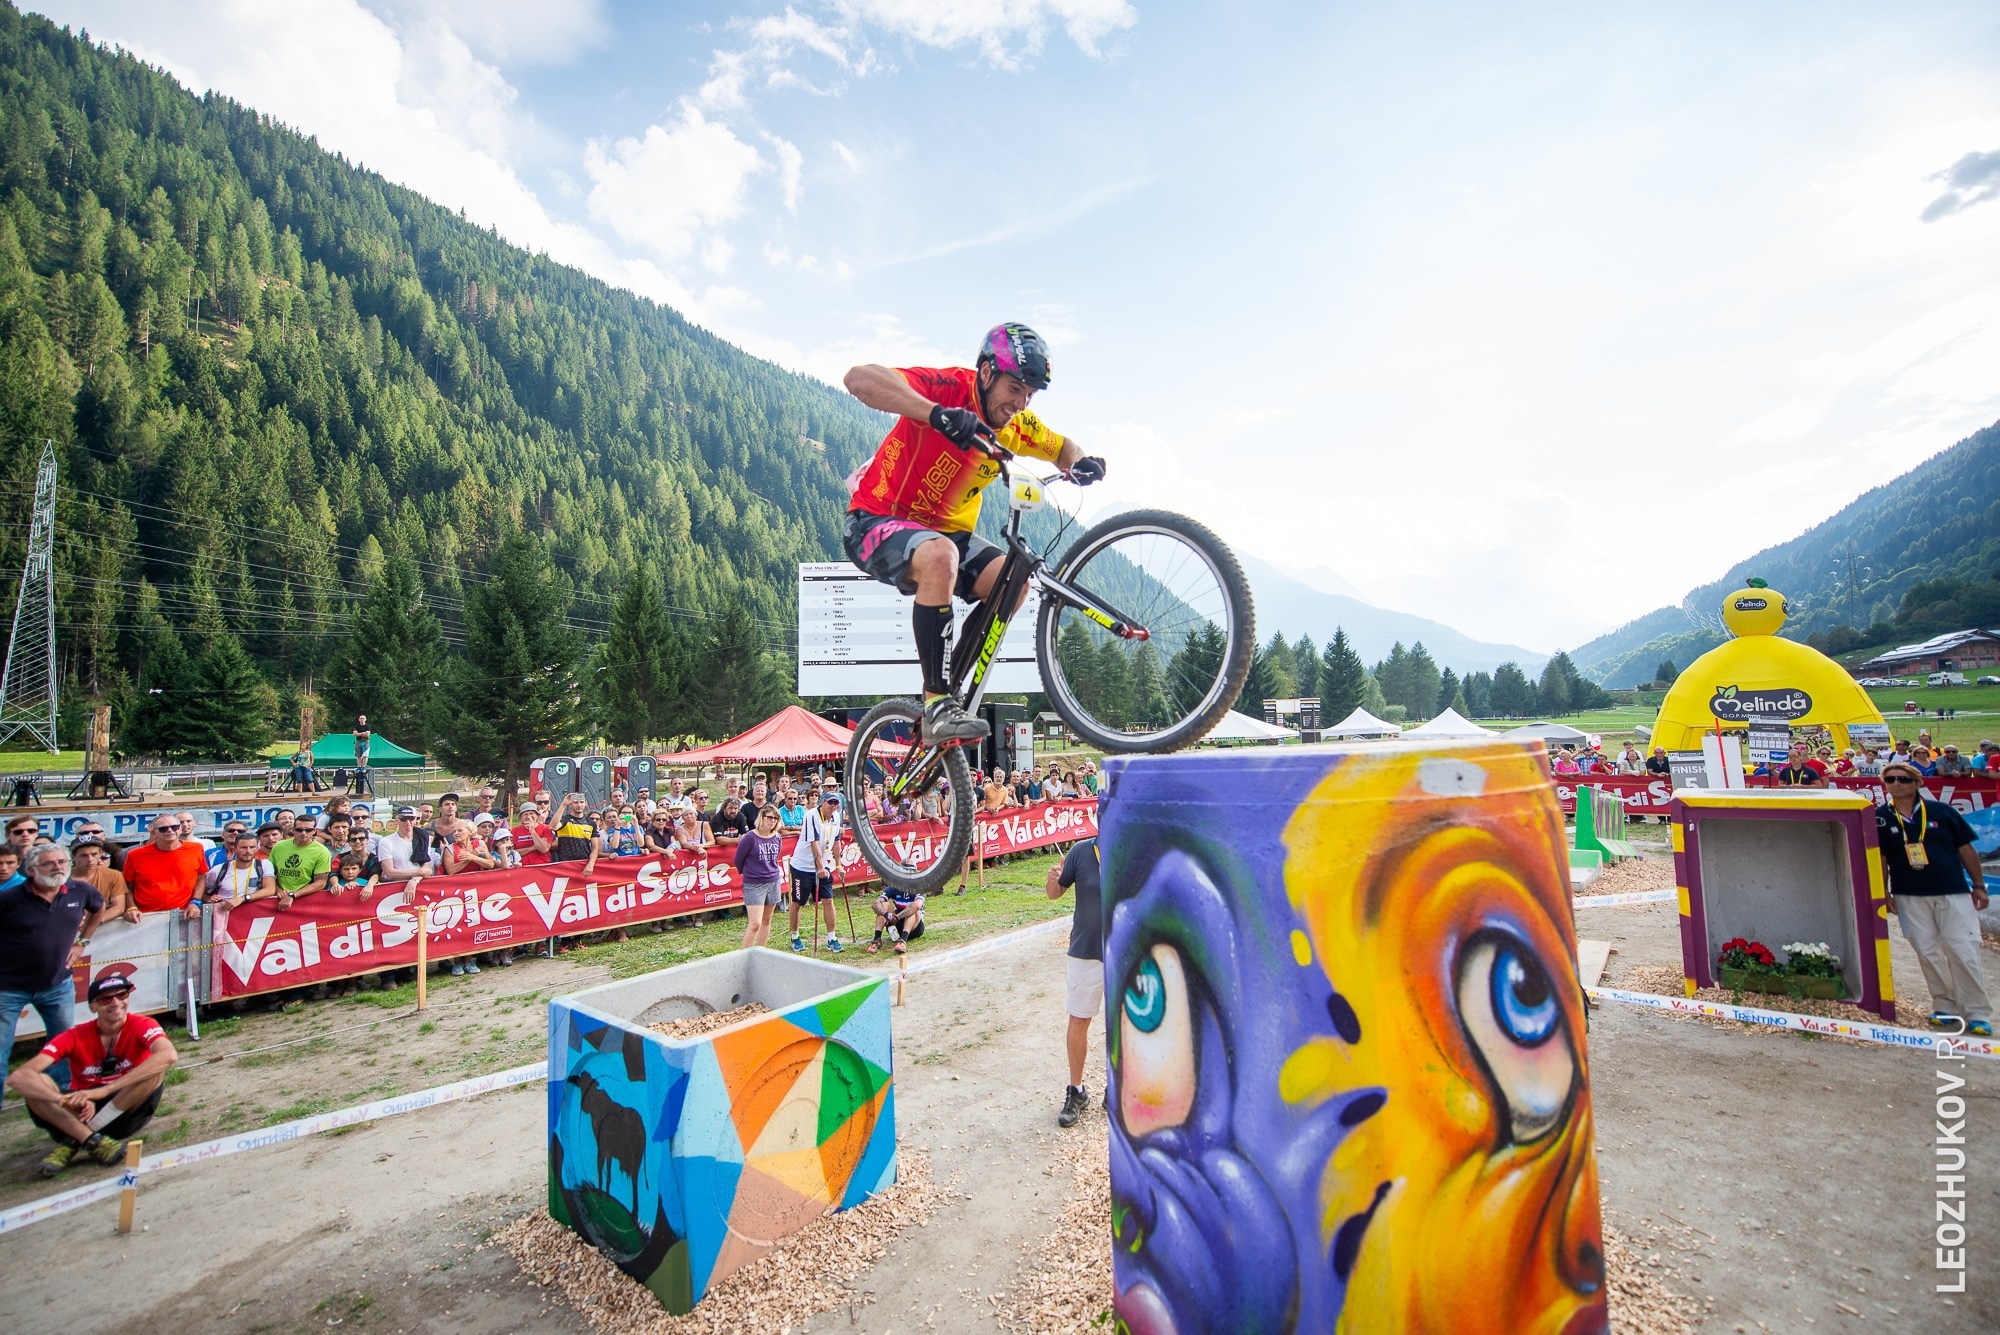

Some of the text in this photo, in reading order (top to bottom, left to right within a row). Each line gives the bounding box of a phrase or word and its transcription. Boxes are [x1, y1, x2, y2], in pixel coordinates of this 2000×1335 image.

[1024, 486, 1032, 501] 4
[974, 613, 1006, 685] JITSIE
[1671, 765, 1706, 774] FINISH
[1685, 777, 1700, 789] 5
[1627, 791, 1649, 807] di
[1002, 815, 1033, 849] Val
[1033, 822, 1047, 839] di
[1044, 806, 1084, 835] Sole
[758, 842, 779, 855] NIKE
[892, 832, 932, 863] Val
[521, 877, 601, 932] Val
[606, 883, 636, 913] di
[636, 857, 733, 906] Sole
[217, 887, 513, 987] Val di Sole
[1671, 1000, 1688, 1011] Val
[1732, 1009, 1788, 1026] TRENTINO
[1800, 1018, 1819, 1031] Val
[1869, 1028, 1933, 1047] TRENTINO
